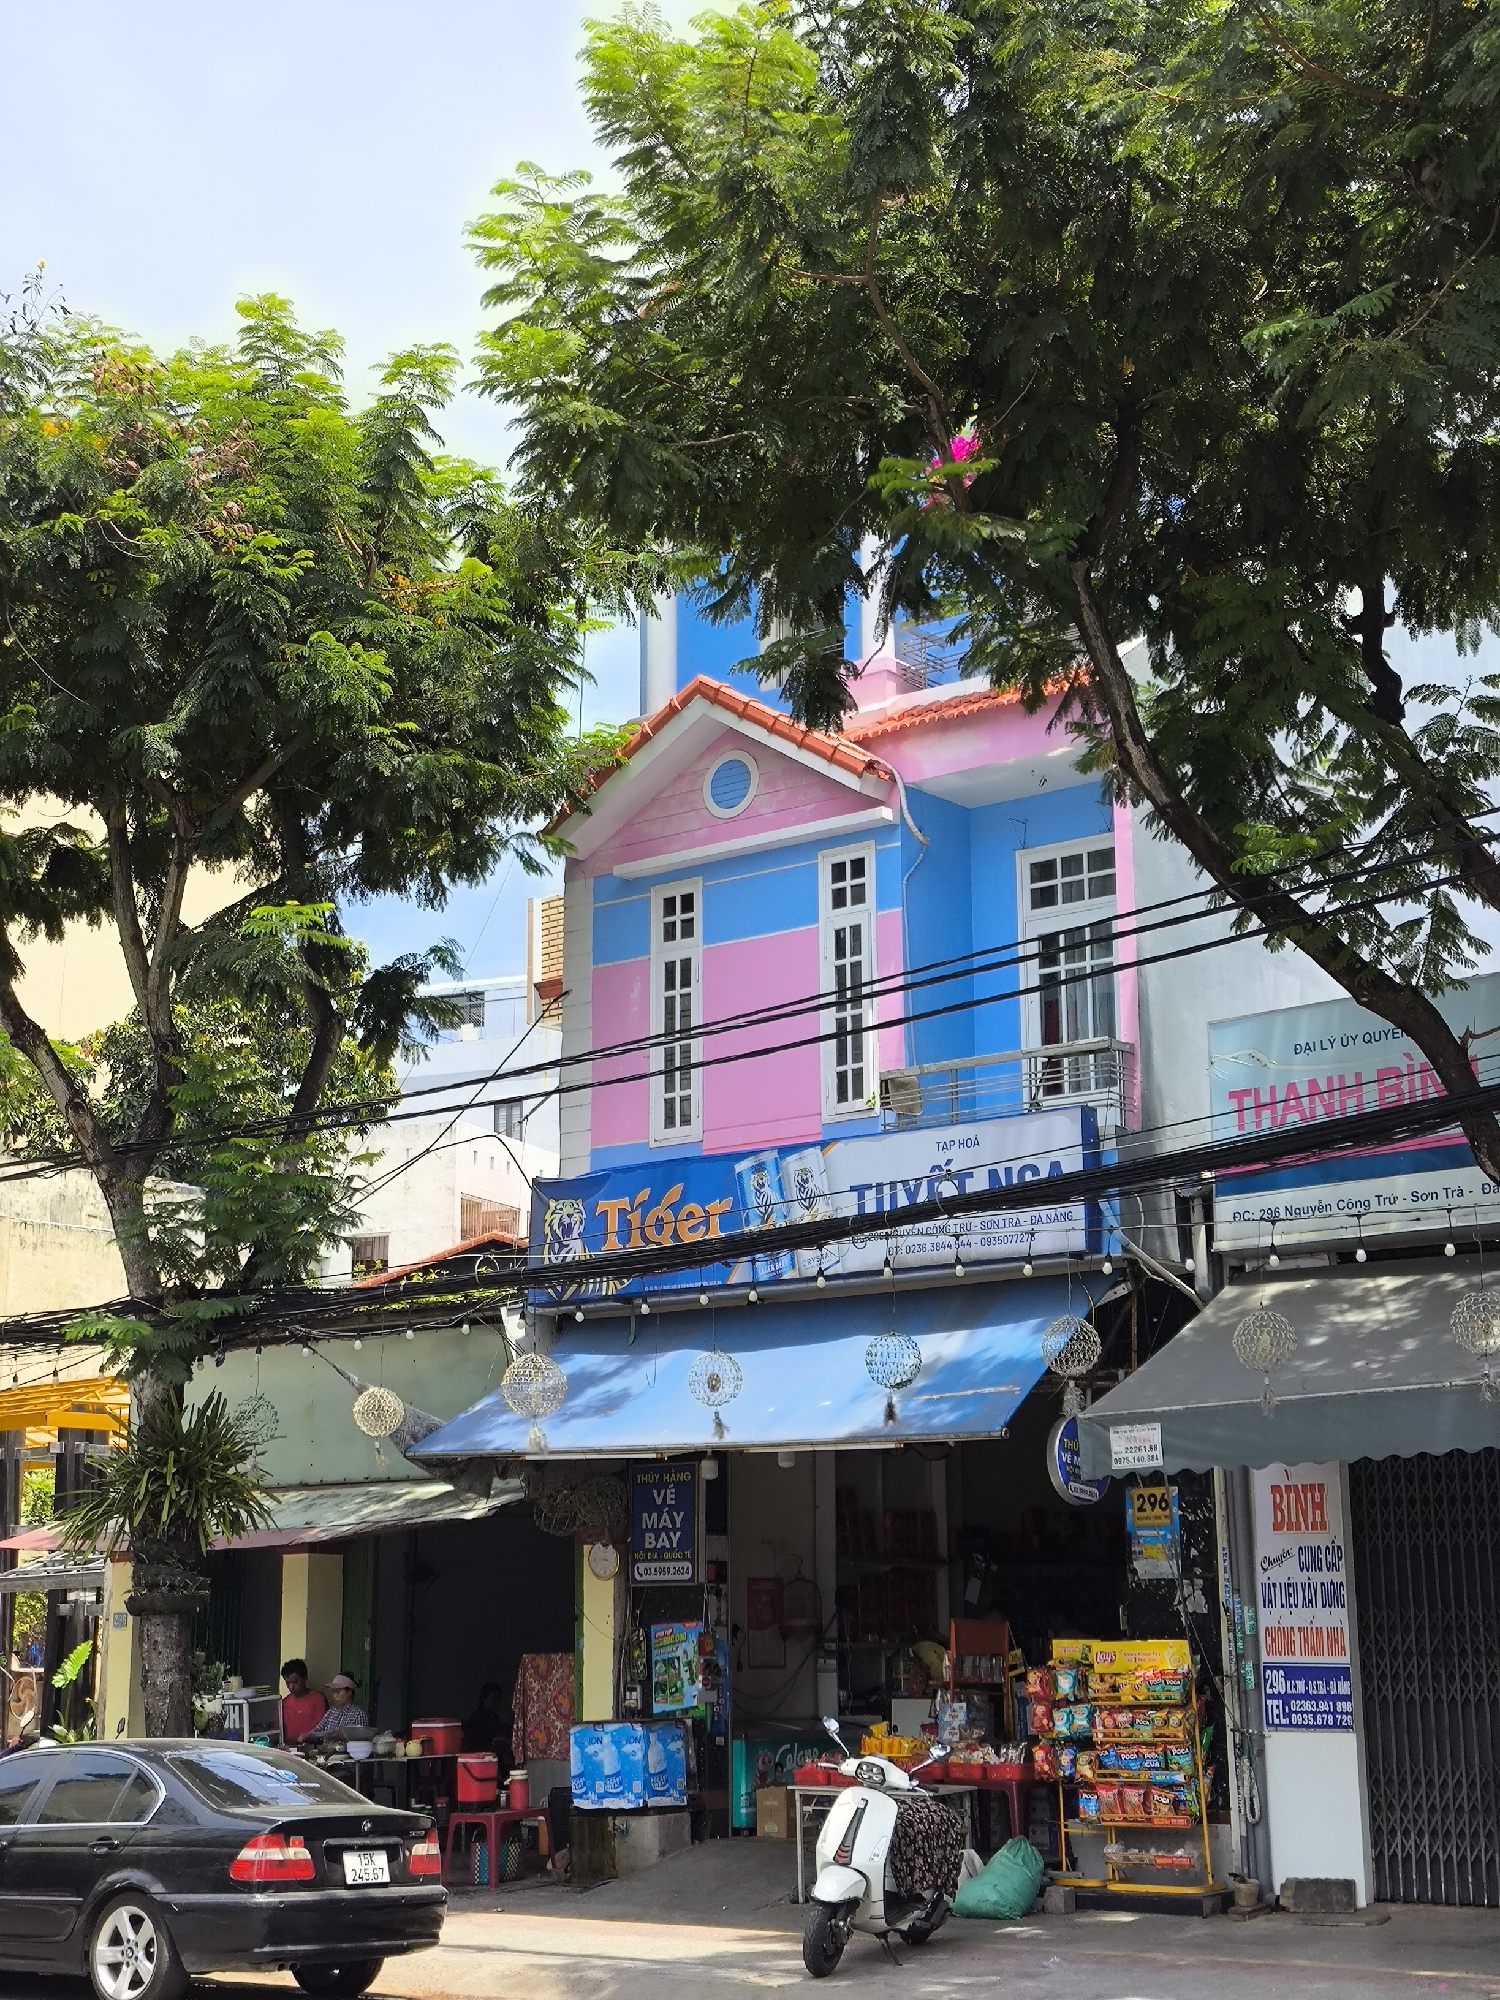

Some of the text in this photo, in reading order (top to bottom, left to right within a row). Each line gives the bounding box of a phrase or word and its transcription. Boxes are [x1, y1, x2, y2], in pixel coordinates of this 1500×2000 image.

[1294, 1042, 1316, 1056] ĐẠI
[1320, 1036, 1337, 1050] LÝ
[1341, 1034, 1359, 1048] ỦY
[1227, 1071, 1364, 1131] THANH
[936, 1134, 980, 1154] TẠP HOÁ
[850, 1159, 974, 1215] TUYẾT
[1233, 1211, 1255, 1222] ĐC:
[1259, 1207, 1280, 1221] 296
[1285, 1200, 1332, 1219] Nguyễn
[1336, 1198, 1371, 1213] Công
[1375, 1194, 1398, 1207] Trứ
[1410, 1189, 1439, 1203] Sơn
[1442, 1185, 1464, 1199] Trà
[596, 1183, 734, 1252] Tiger
[953, 1220, 973, 1234] TRỨ
[980, 1219, 999, 1231] SƠN
[1002, 1214, 1021, 1228] TRÀ
[1030, 1212, 1044, 1226] ĐÀ
[905, 1241, 952, 1255] 0236.3844
[637, 1471, 660, 1484] THÚY
[653, 1483, 676, 1505] VÉ
[1137, 1493, 1170, 1512] 296
[1270, 1468, 1330, 1534] BÌNH
[641, 1507, 685, 1529] MÁY
[644, 1531, 681, 1549] BAY
[1298, 1544, 1323, 1572] CUNG
[1325, 1535, 1344, 1573] CẤP
[1261, 1576, 1346, 1616] VẬT LIỆU XÂY DỰNG
[1264, 1615, 1296, 1657] CHỐNG
[1298, 1615, 1325, 1657] THẤM
[1326, 1620, 1347, 1657] NHÀ
[1265, 1669, 1287, 1695] 296
[1266, 1699, 1353, 1725] TEL: 02363.941 898
[1291, 1714, 1353, 1726] 0935.678 729
[1154, 1795, 1170, 1804] POCA
[358, 1853, 376, 1866] 15K
[351, 1867, 385, 1882] 245.67
